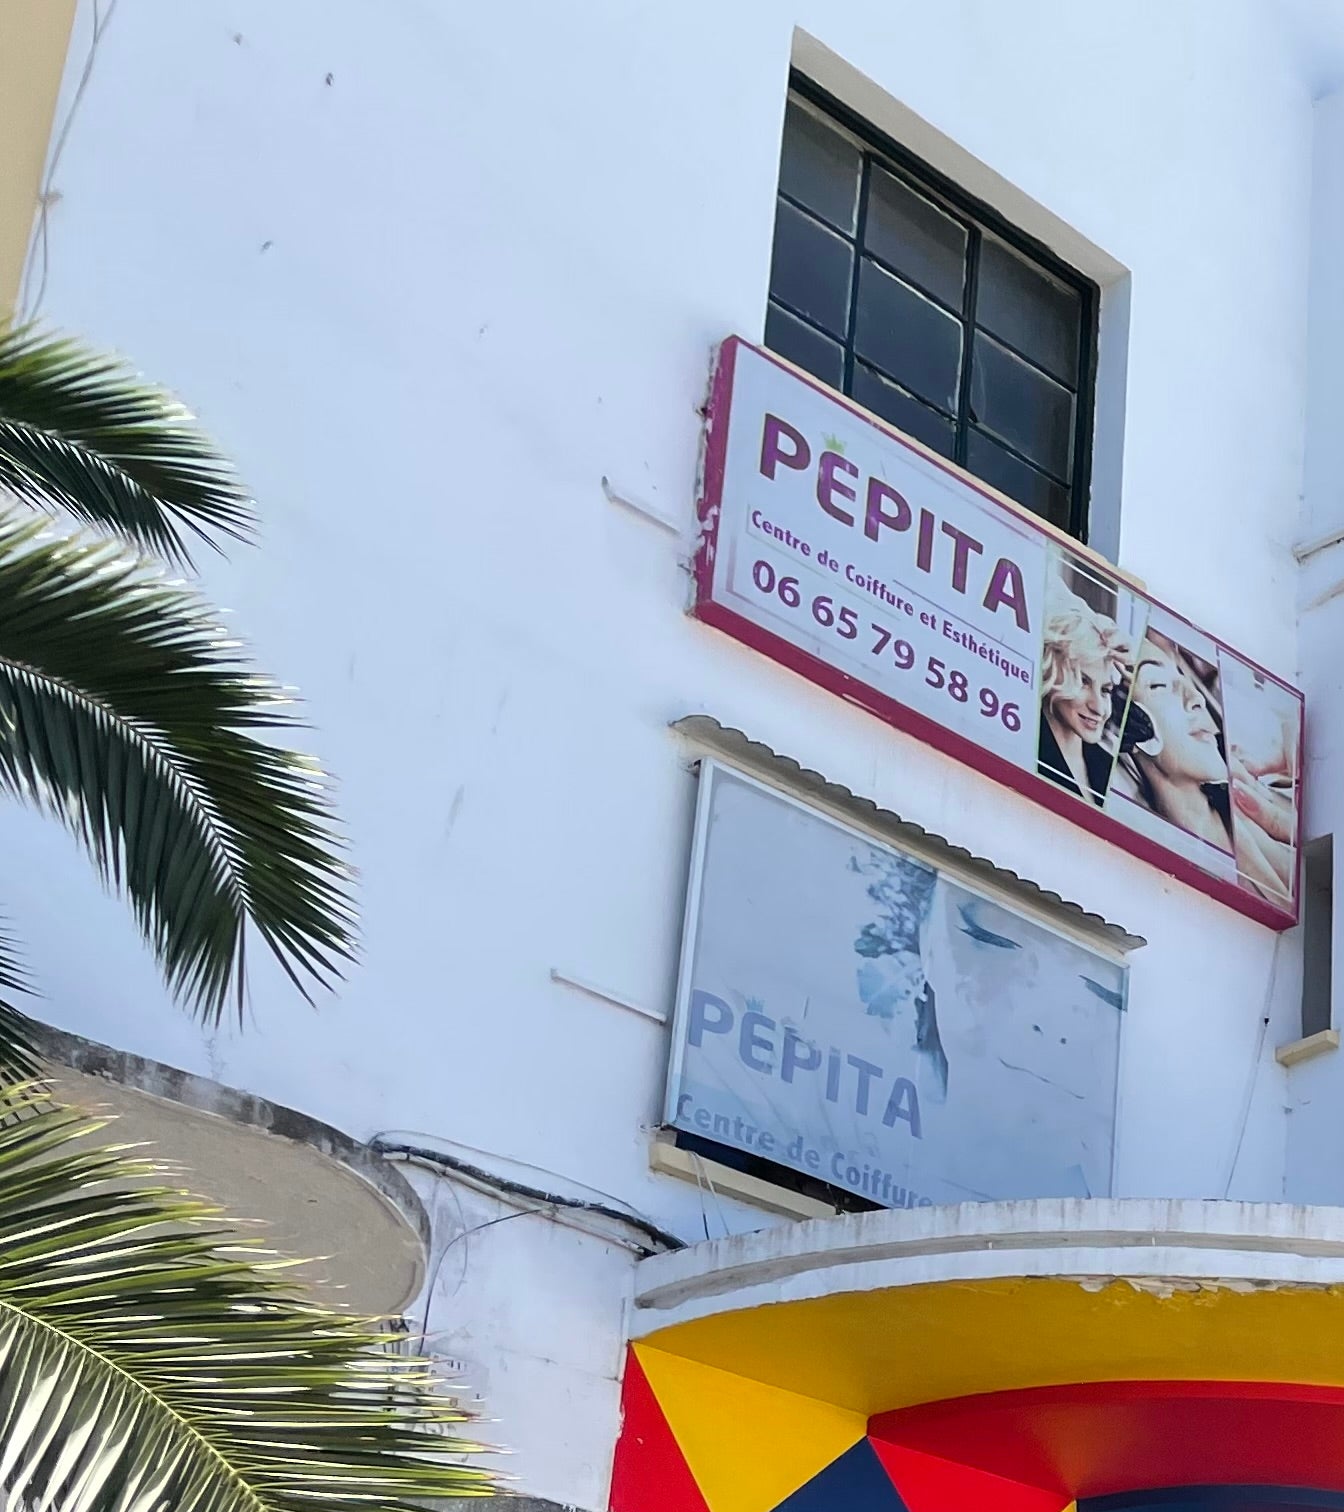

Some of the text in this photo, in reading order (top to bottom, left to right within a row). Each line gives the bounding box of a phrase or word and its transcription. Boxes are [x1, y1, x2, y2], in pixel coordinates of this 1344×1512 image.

[752, 509, 1030, 684] Centre de Coiffure et Esthétique
[752, 559, 1021, 733] 06 65 79 58 96
[677, 1093, 775, 1153] Centre
[788, 1134, 819, 1168] de
